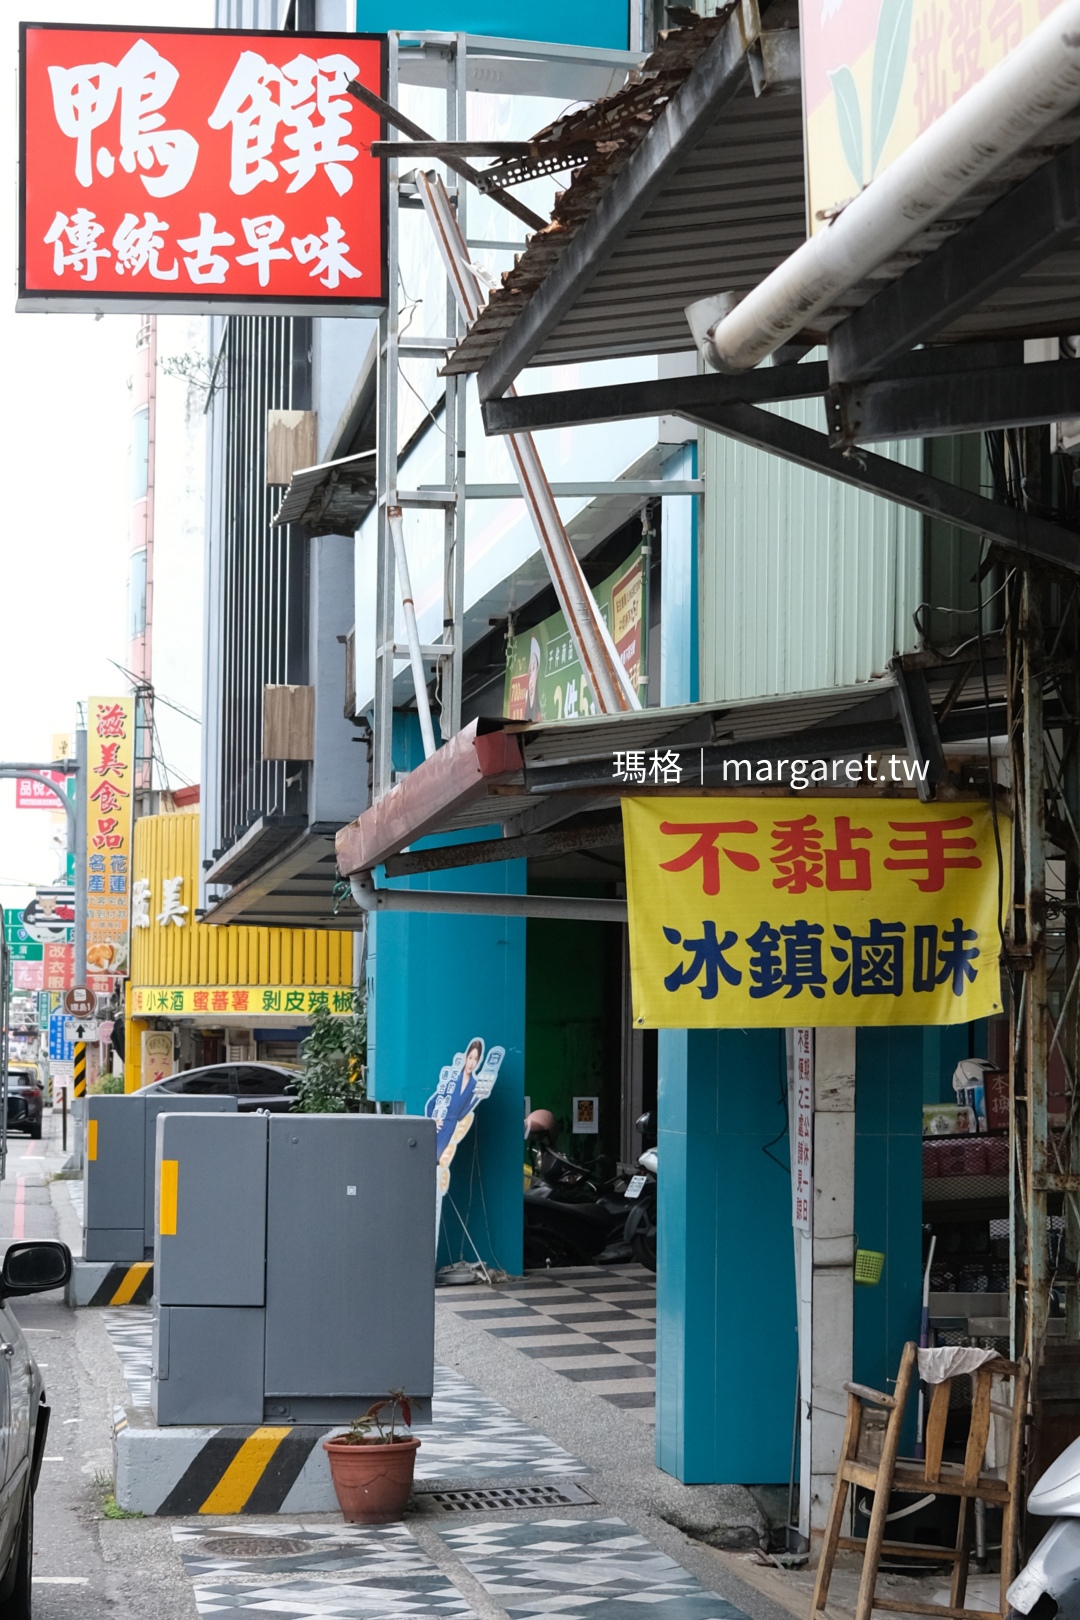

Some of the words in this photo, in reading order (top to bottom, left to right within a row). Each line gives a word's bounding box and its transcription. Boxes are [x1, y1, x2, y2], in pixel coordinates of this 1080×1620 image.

[47, 38, 360, 199] 鴨饌
[44, 207, 363, 290] 傳統古早味
[90, 703, 128, 849] 滋美食品
[109, 854, 128, 894] 花蓮
[659, 814, 983, 896] 不黏手
[662, 916, 981, 1000] 冰鎮滷味
[146, 990, 184, 1011] 小米酒
[192, 990, 250, 1011] 蜜蕃薯
